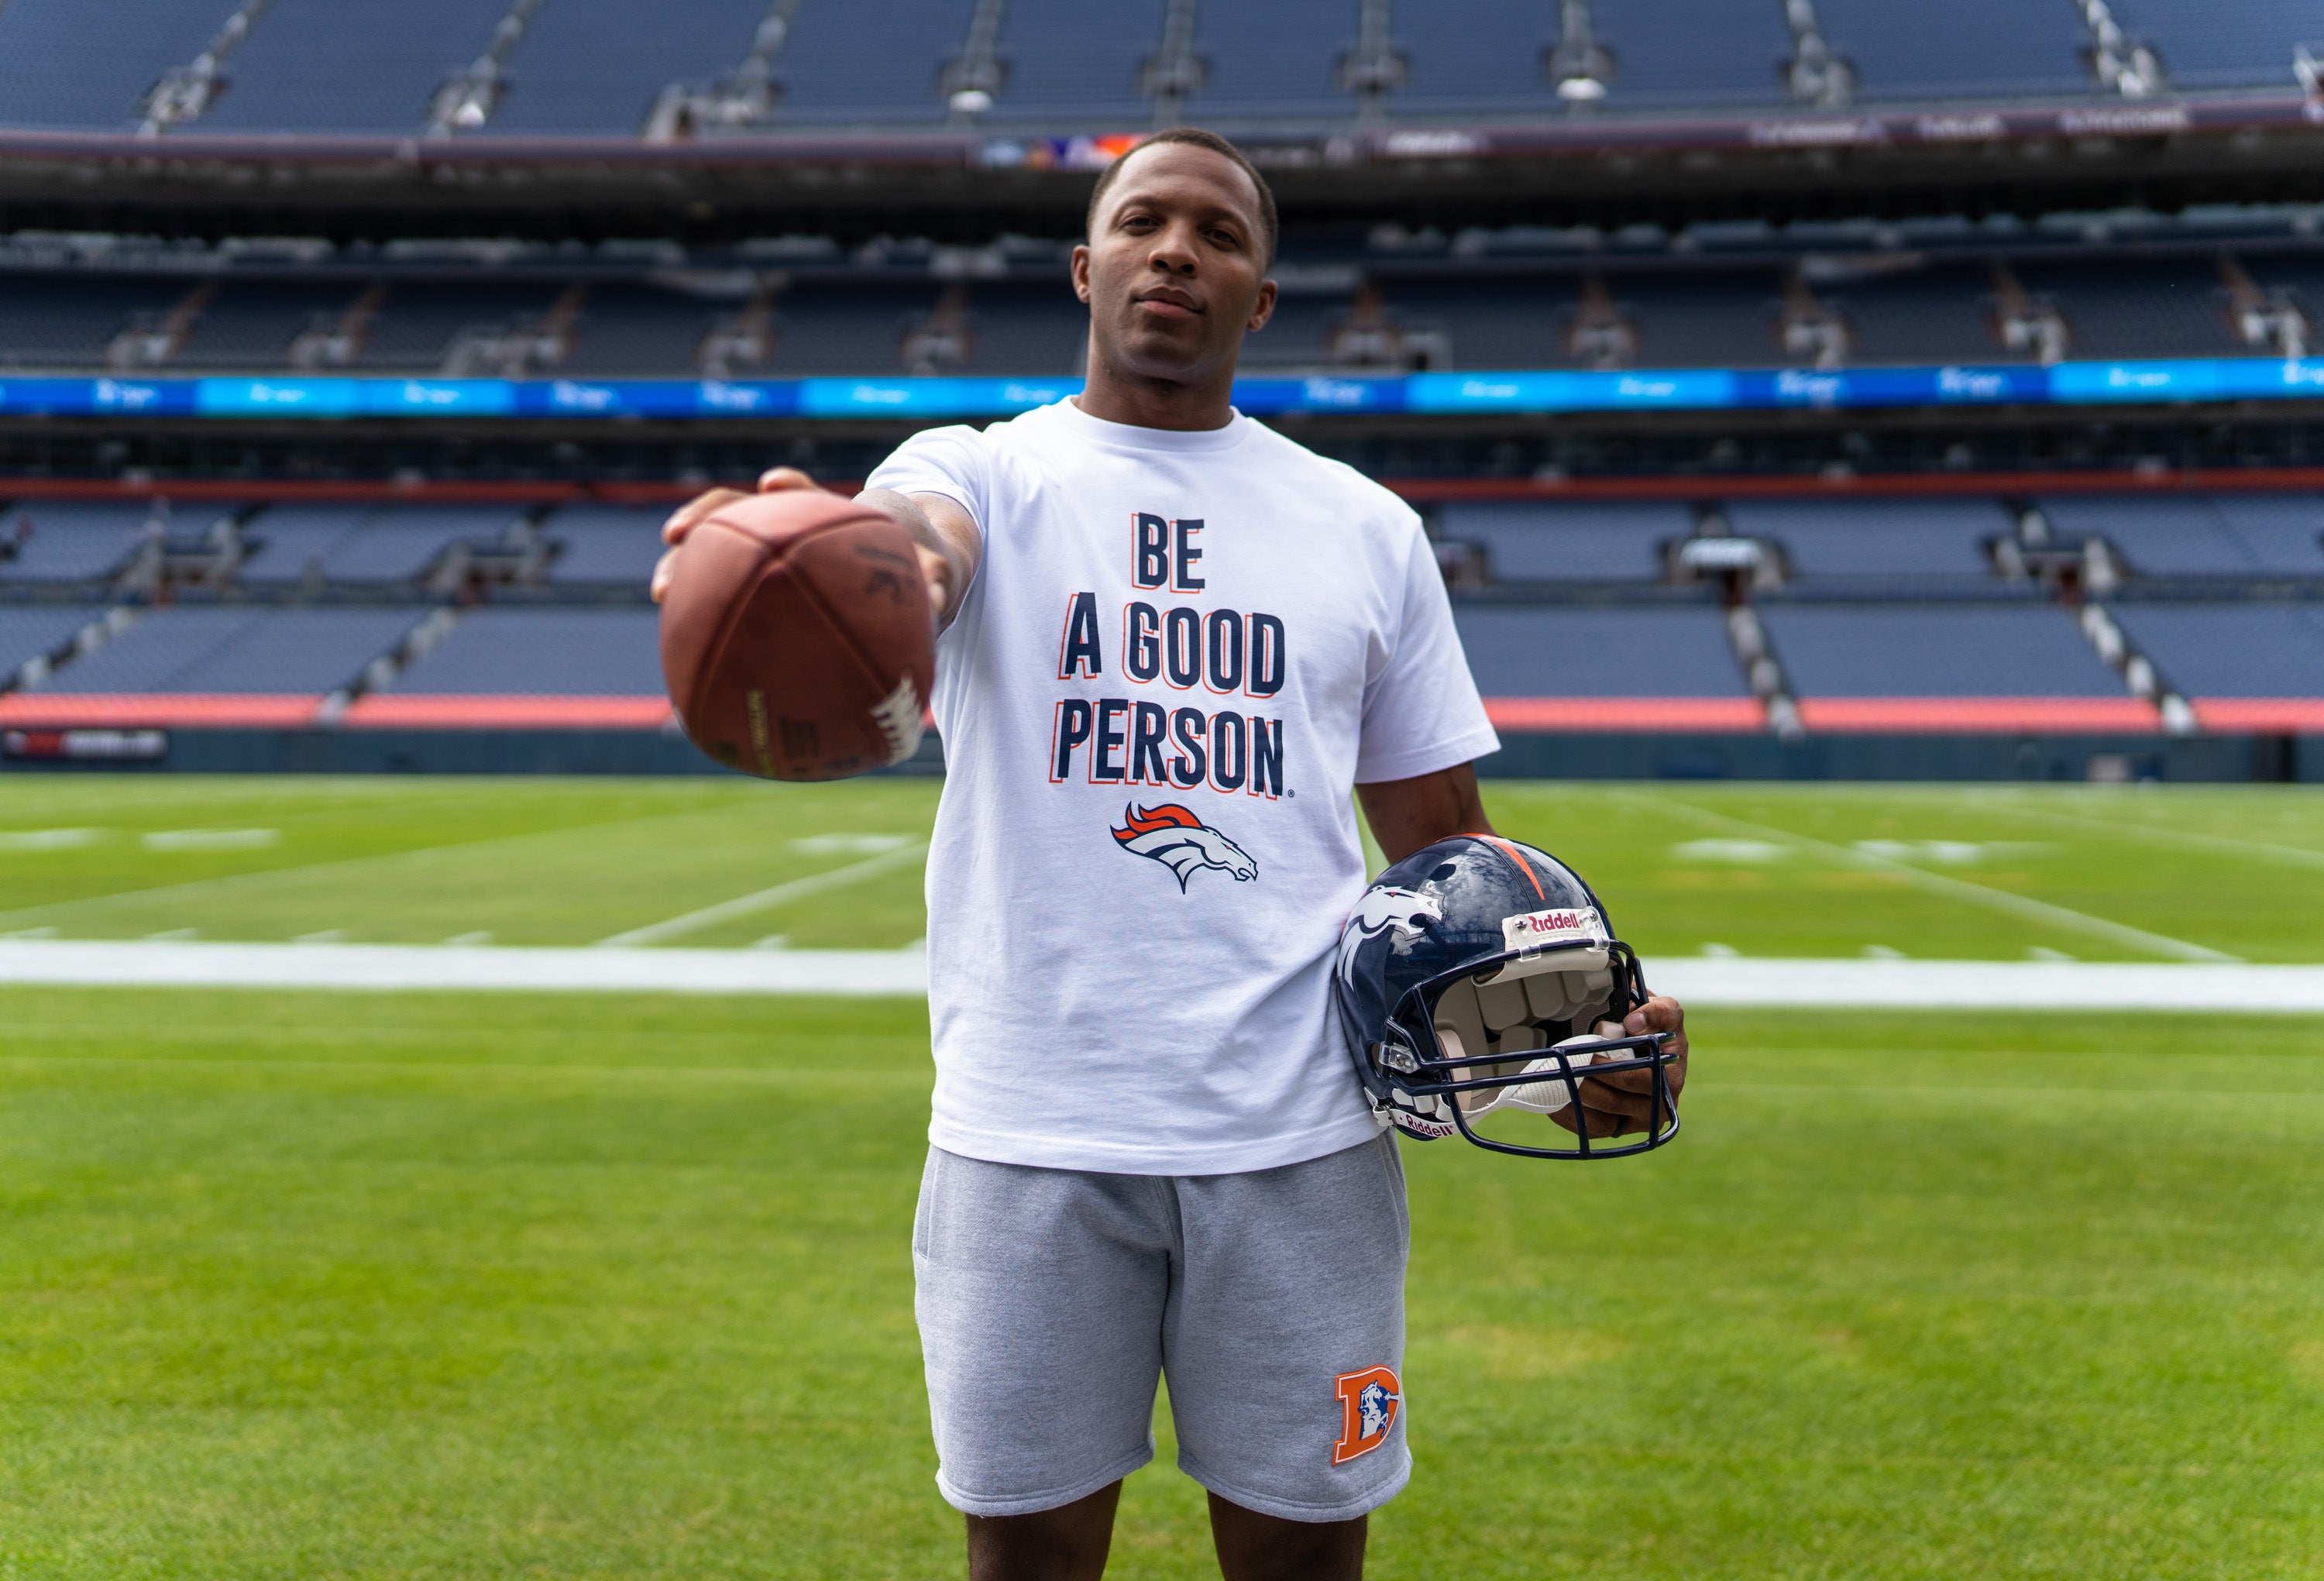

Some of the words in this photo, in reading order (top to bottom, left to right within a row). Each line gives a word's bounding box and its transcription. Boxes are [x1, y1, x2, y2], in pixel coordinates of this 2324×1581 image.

[1132, 512, 1205, 593] BE
[1057, 592, 1102, 680] A
[1122, 601, 1285, 699] GOOD
[1049, 699, 1284, 800] PERSON
[1527, 912, 1580, 933] Riddell
[1405, 1114, 1453, 1137] Riddell
[1332, 1364, 1401, 1466] D
